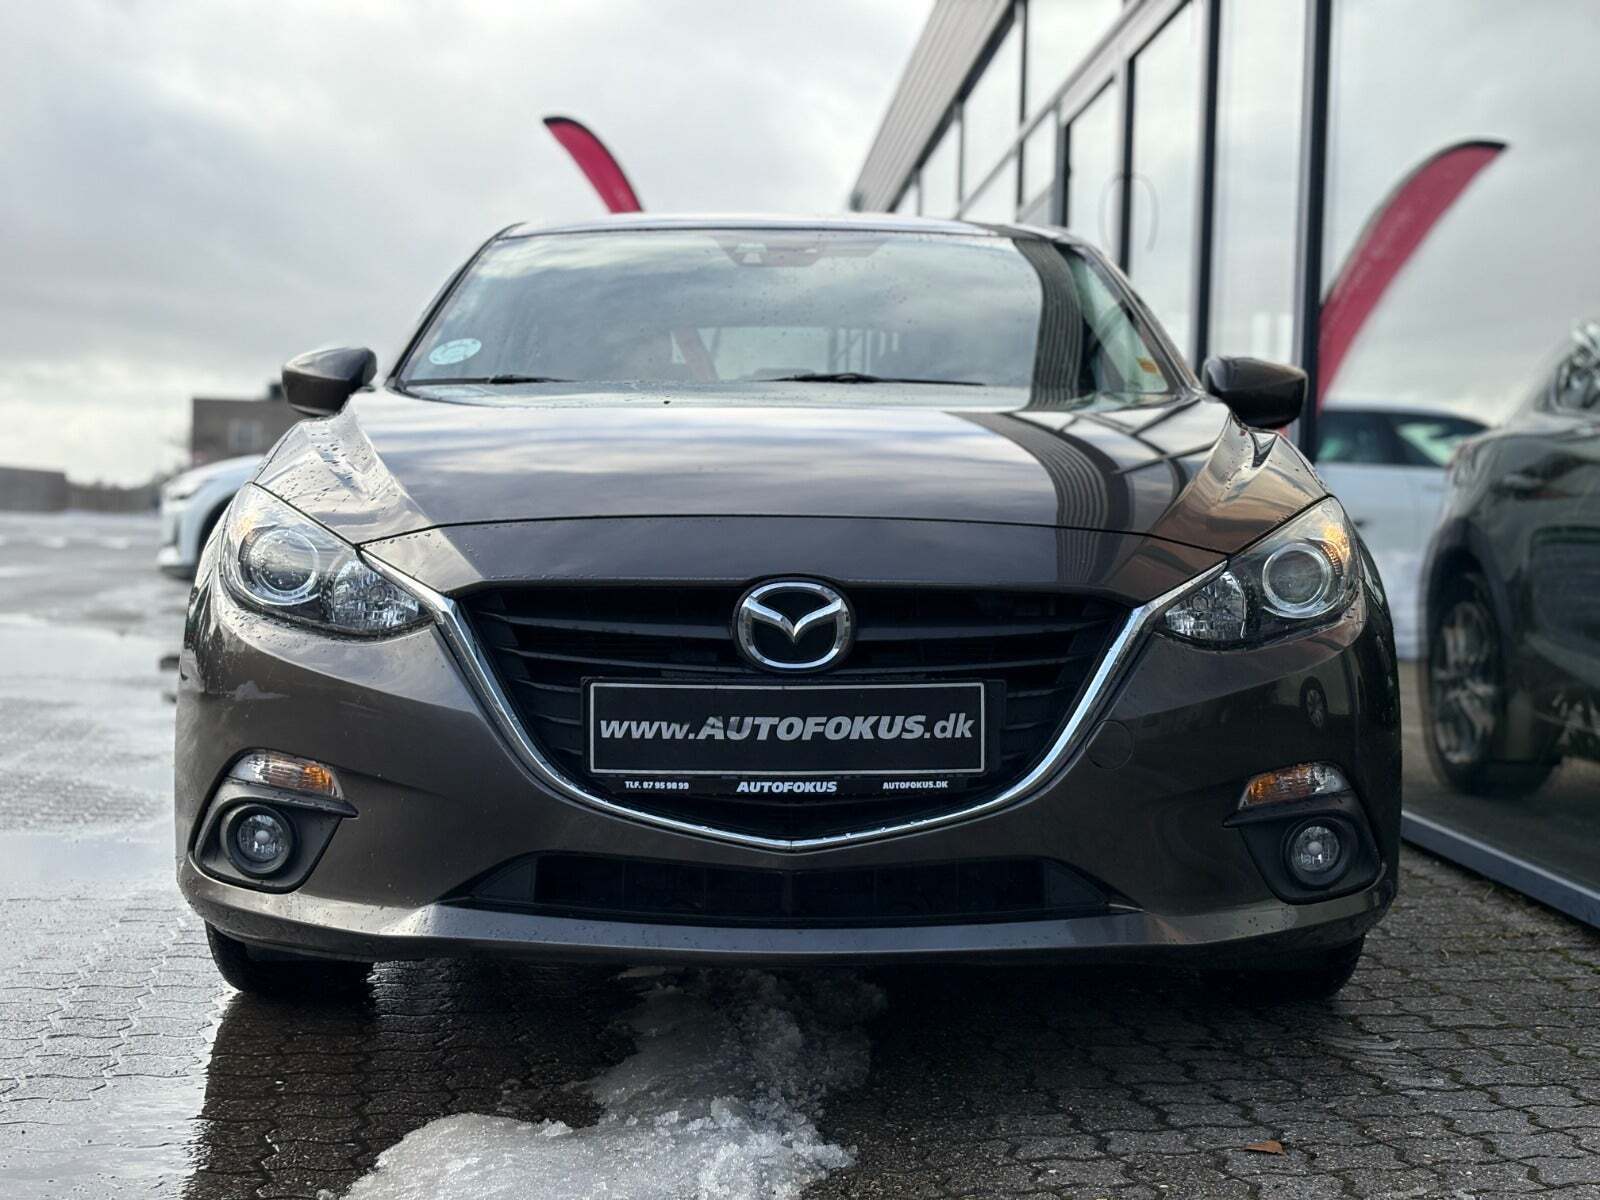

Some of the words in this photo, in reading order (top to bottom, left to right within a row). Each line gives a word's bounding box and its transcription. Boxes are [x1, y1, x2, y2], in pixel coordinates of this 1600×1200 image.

[600, 713, 973, 740] www.AUTOFOKUS.dk
[624, 780, 641, 789] TLF.
[736, 782, 837, 792] AUTOFOKUS
[883, 781, 948, 789] AUTOFOKUS.DK
